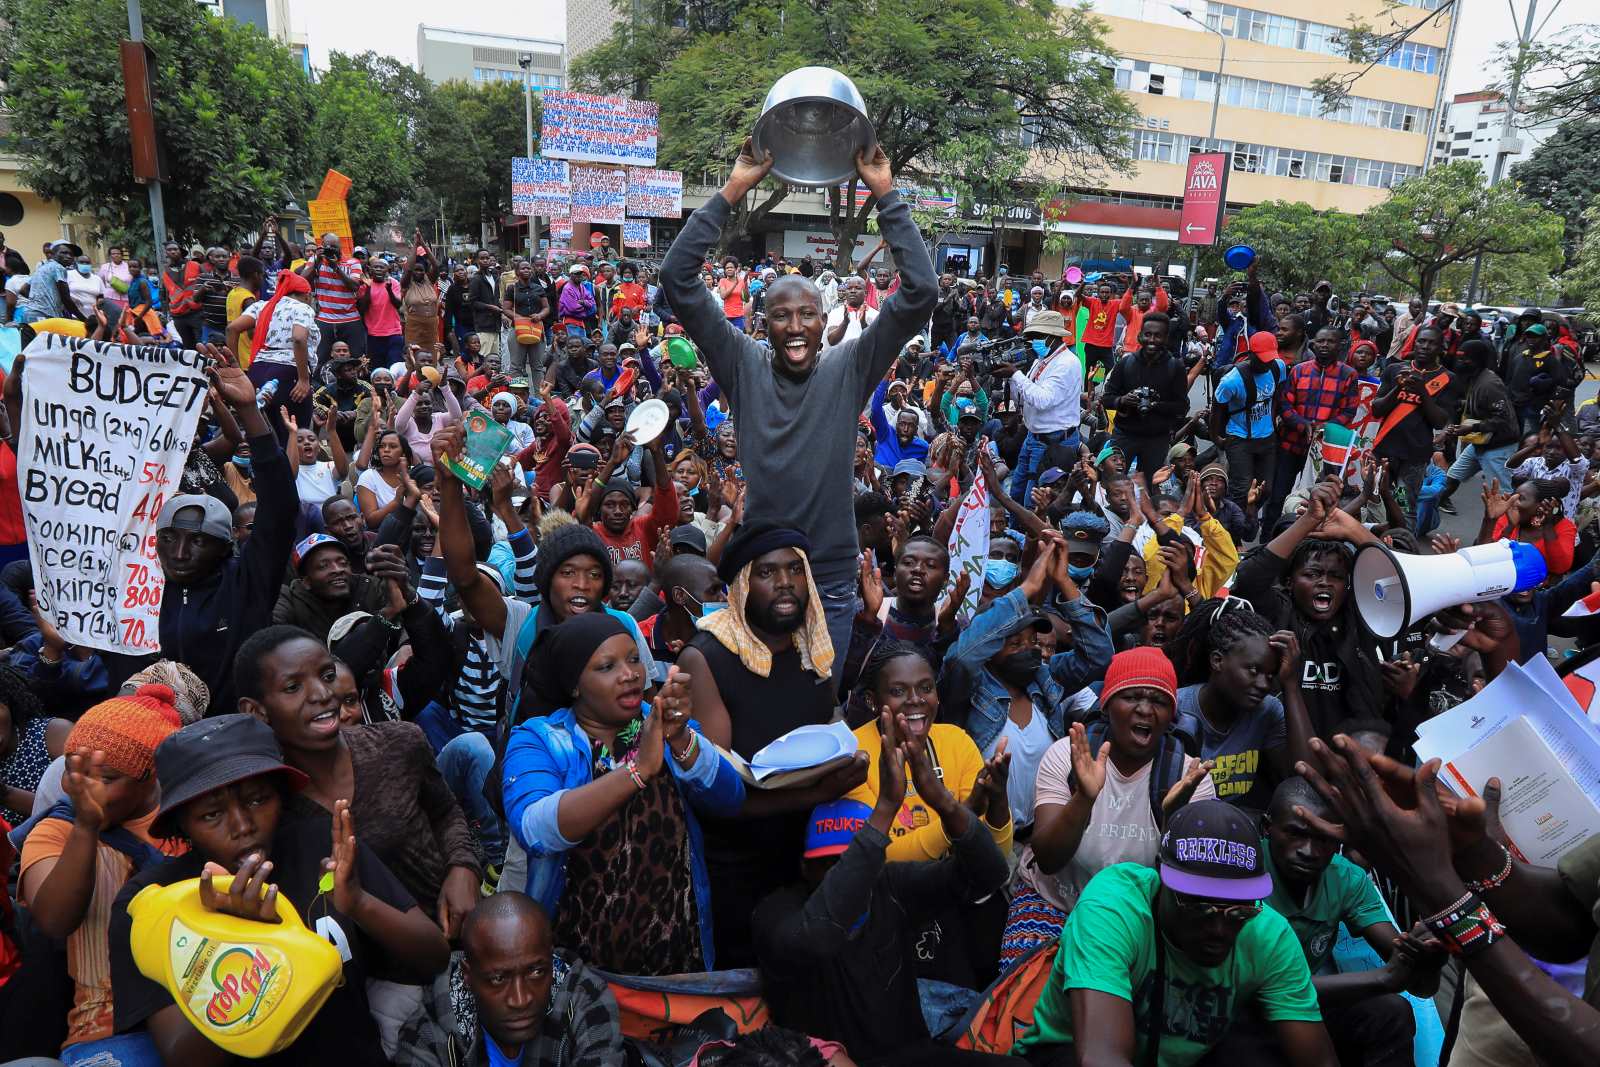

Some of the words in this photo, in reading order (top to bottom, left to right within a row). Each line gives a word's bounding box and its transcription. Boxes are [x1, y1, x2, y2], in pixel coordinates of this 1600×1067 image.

[577, 145, 588, 153] THE
[591, 147, 616, 155] HOSPITAL
[1187, 175, 1217, 190] JAVA
[972, 202, 1033, 220] SAUNG
[68, 352, 209, 413] BUDGET
[27, 512, 117, 560] ooking
[34, 543, 77, 569] ice
[126, 563, 149, 586] 70
[123, 585, 162, 610] 800
[120, 617, 146, 648] 70
[815, 817, 865, 834] TRUKF
[1176, 837, 1257, 871] RECKLESS
[241, 947, 271, 997] Fry
[207, 973, 240, 1022] Top
